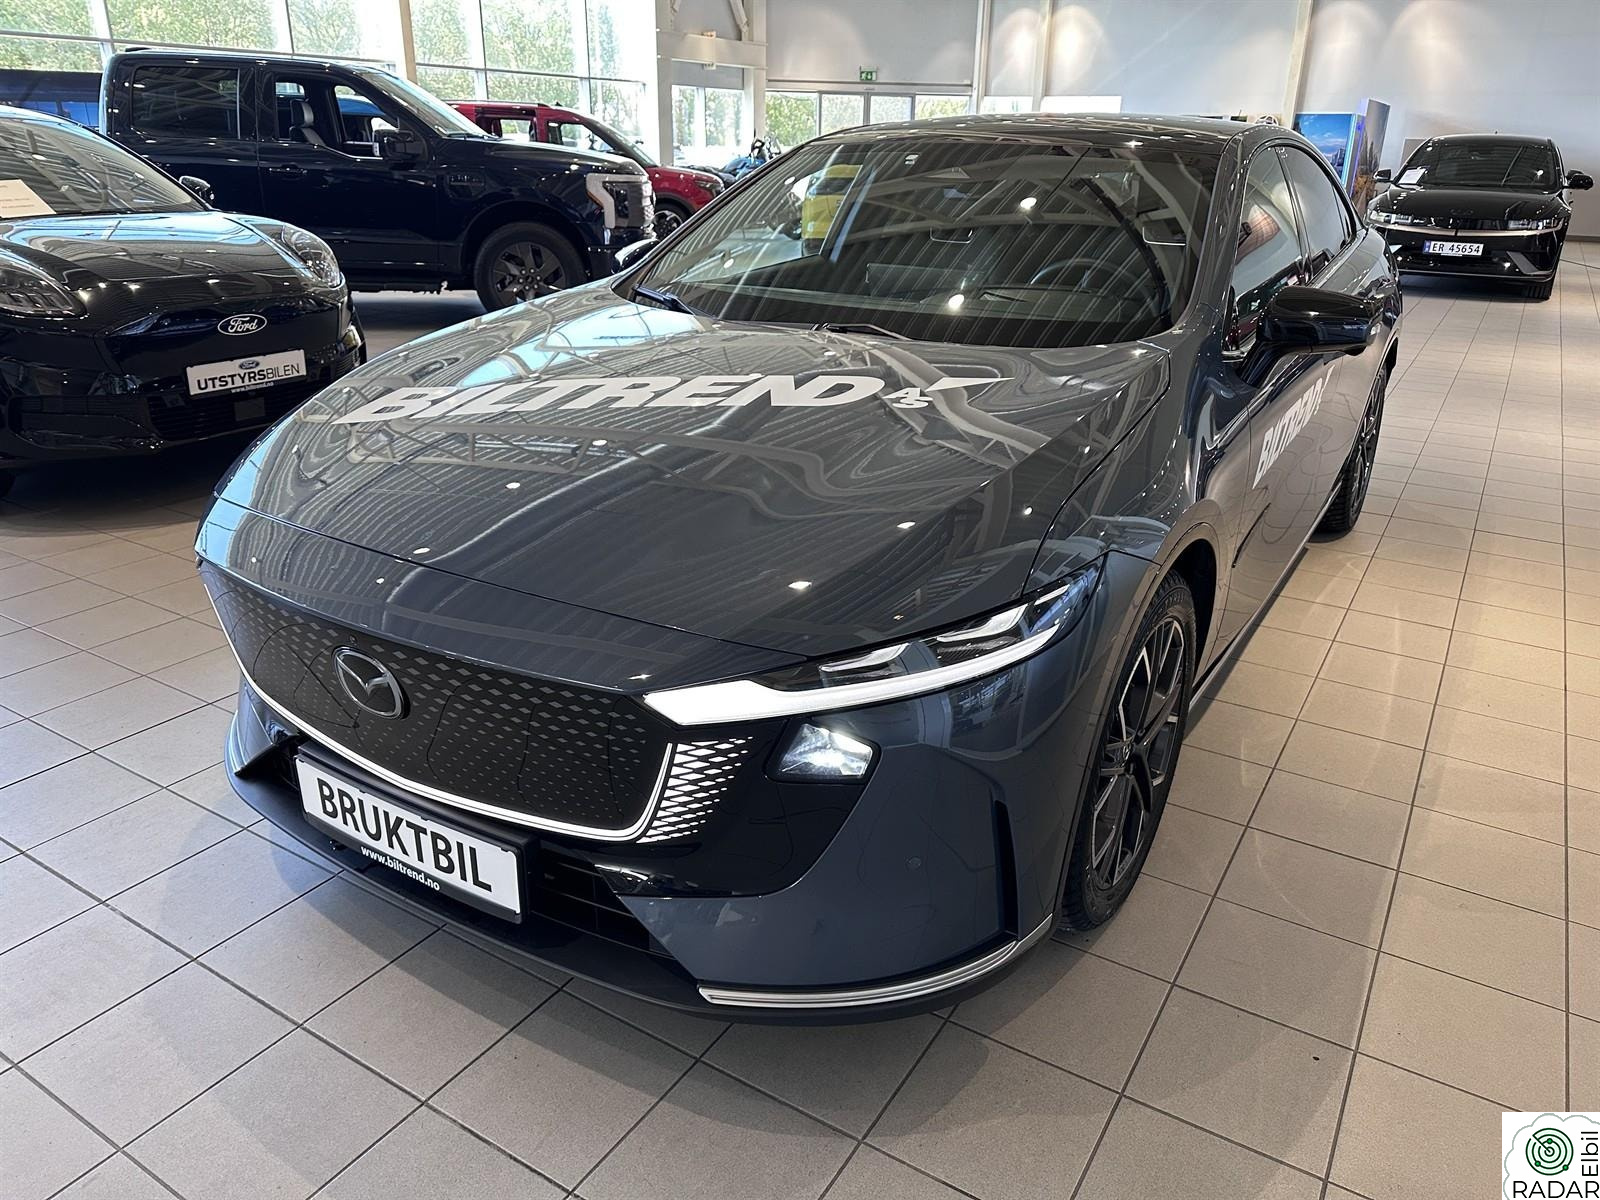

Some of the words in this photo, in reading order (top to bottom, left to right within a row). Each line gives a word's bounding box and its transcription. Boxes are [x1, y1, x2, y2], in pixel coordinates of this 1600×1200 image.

[1432, 242, 1445, 252] ER
[1448, 243, 1481, 254] 45654
[228, 316, 258, 333] Ford
[197, 363, 301, 391] UTSTYRSBILEN
[331, 376, 886, 425] BILTREND
[317, 777, 493, 893] BRUKTBIL
[360, 846, 441, 892] www.biltrend.no
